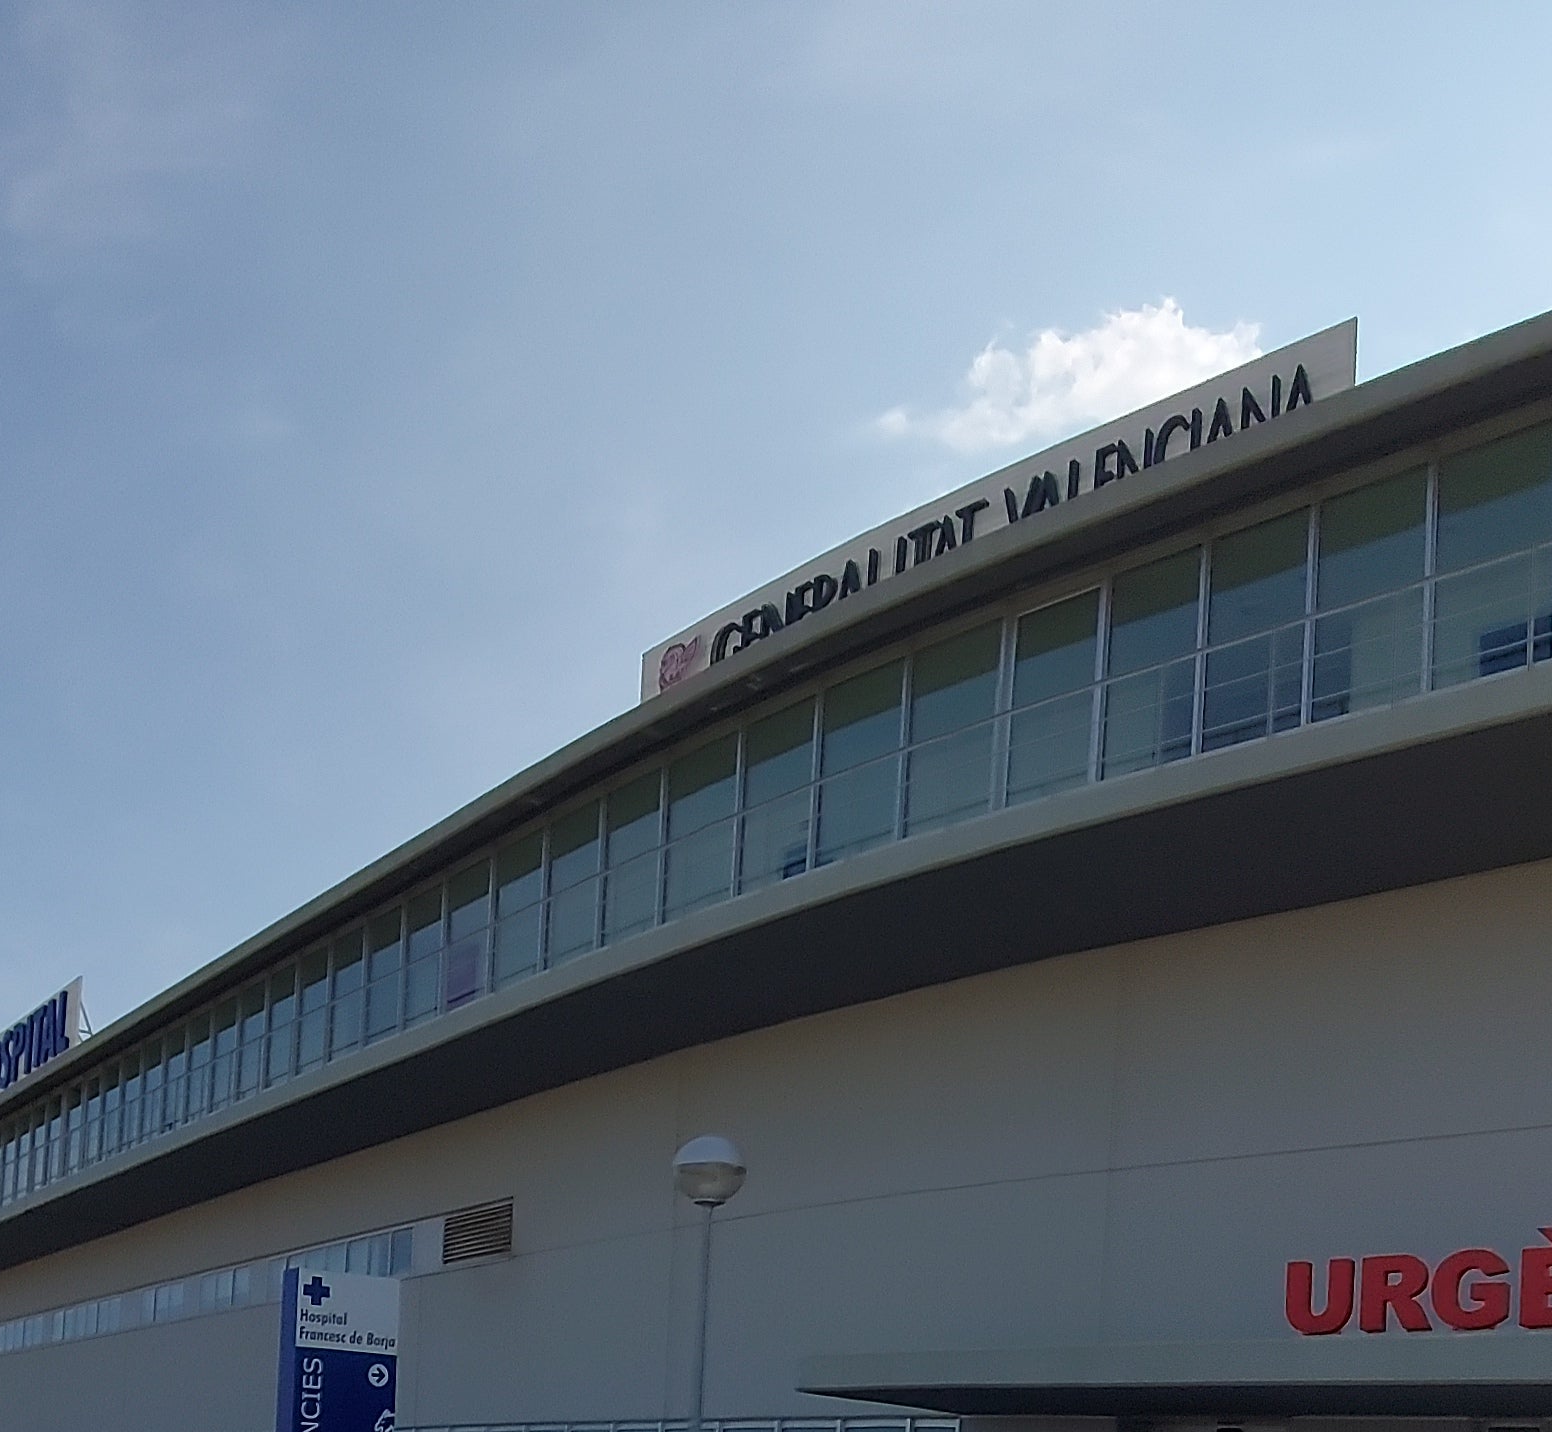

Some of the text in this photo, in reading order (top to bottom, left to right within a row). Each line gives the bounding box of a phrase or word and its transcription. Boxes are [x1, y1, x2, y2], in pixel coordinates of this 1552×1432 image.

[300, 1308, 348, 1326] Hospital
[299, 1325, 396, 1350] Francesc de Borja
